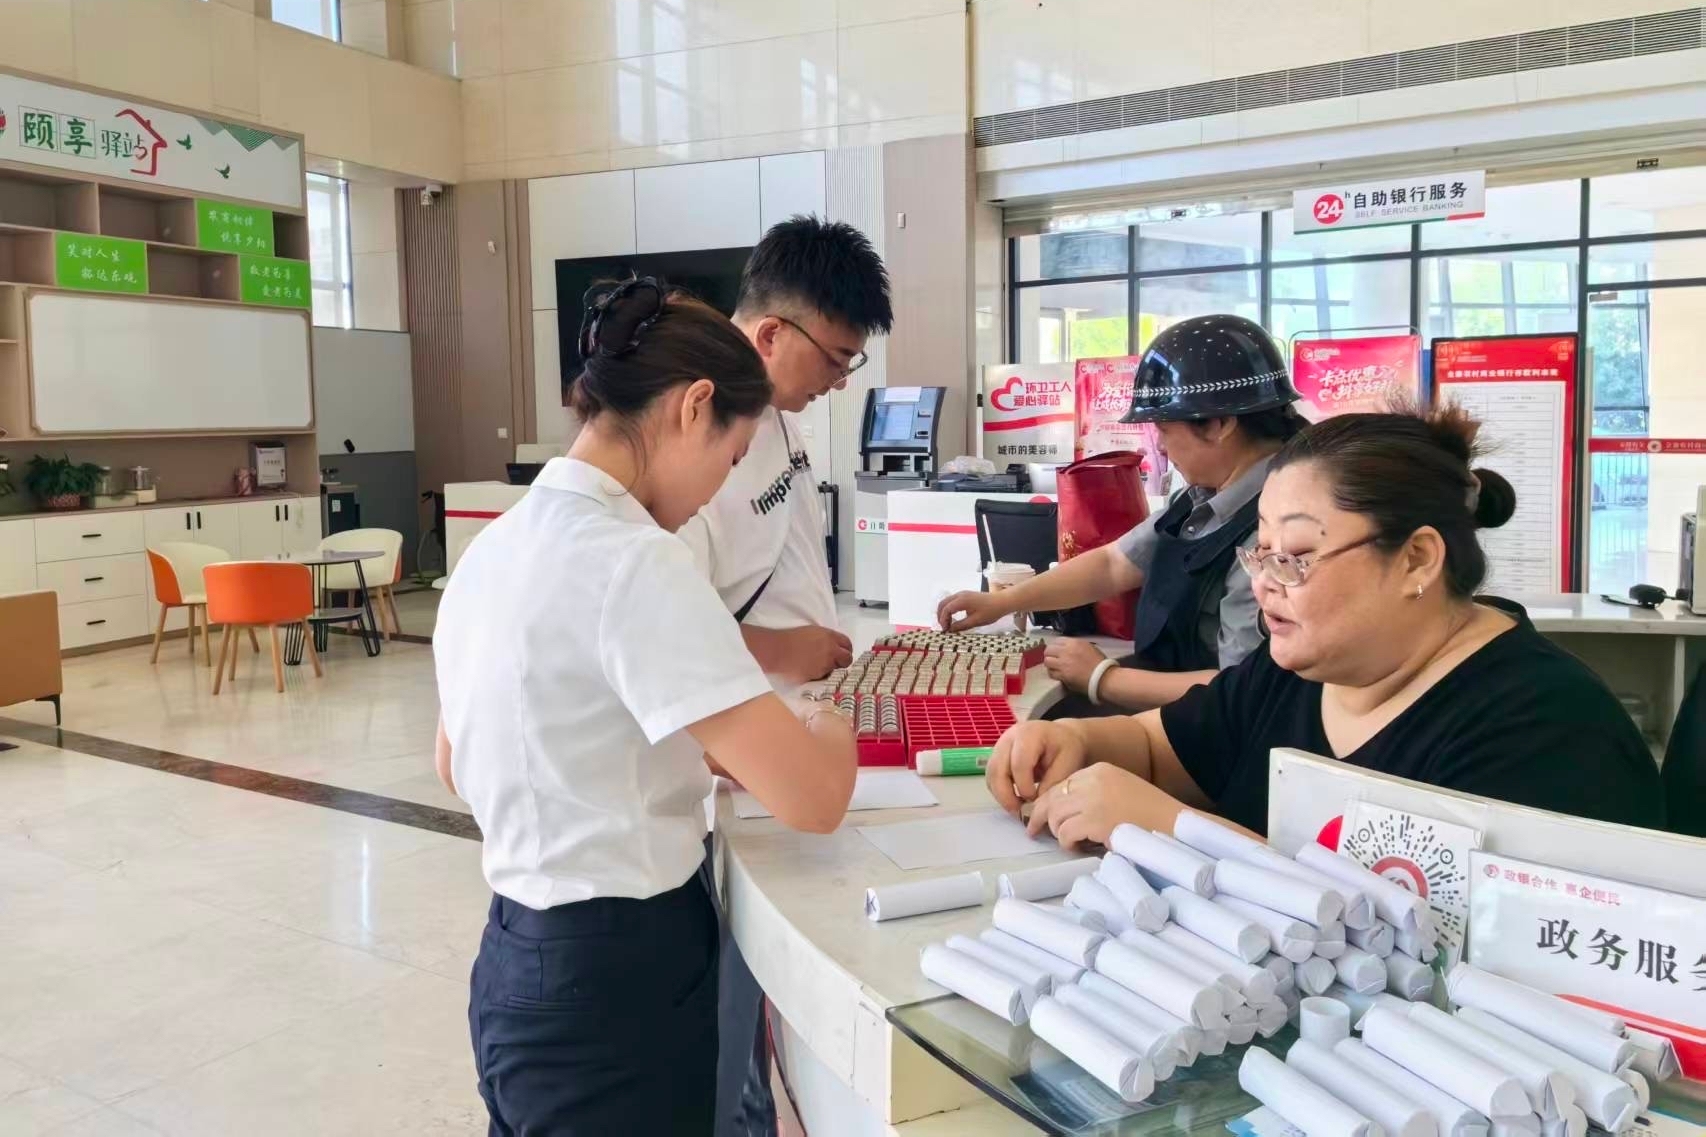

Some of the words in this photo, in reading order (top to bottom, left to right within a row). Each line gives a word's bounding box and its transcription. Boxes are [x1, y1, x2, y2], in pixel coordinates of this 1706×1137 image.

[23, 112, 148, 160] 颐享驿站
[1354, 181, 1467, 209] 自助银行服务
[1355, 210, 1377, 219] SELF
[1381, 206, 1418, 217] SERVICE
[1422, 201, 1464, 212] BANKING
[67, 243, 121, 263] 笑对人生
[1024, 381, 1072, 394] 环卫工人
[1013, 394, 1061, 407] 爱心驿站
[997, 444, 1058, 456] 城市的美容师
[1503, 868, 1558, 891] 政银合作
[1565, 881, 1621, 906] 惠企便民
